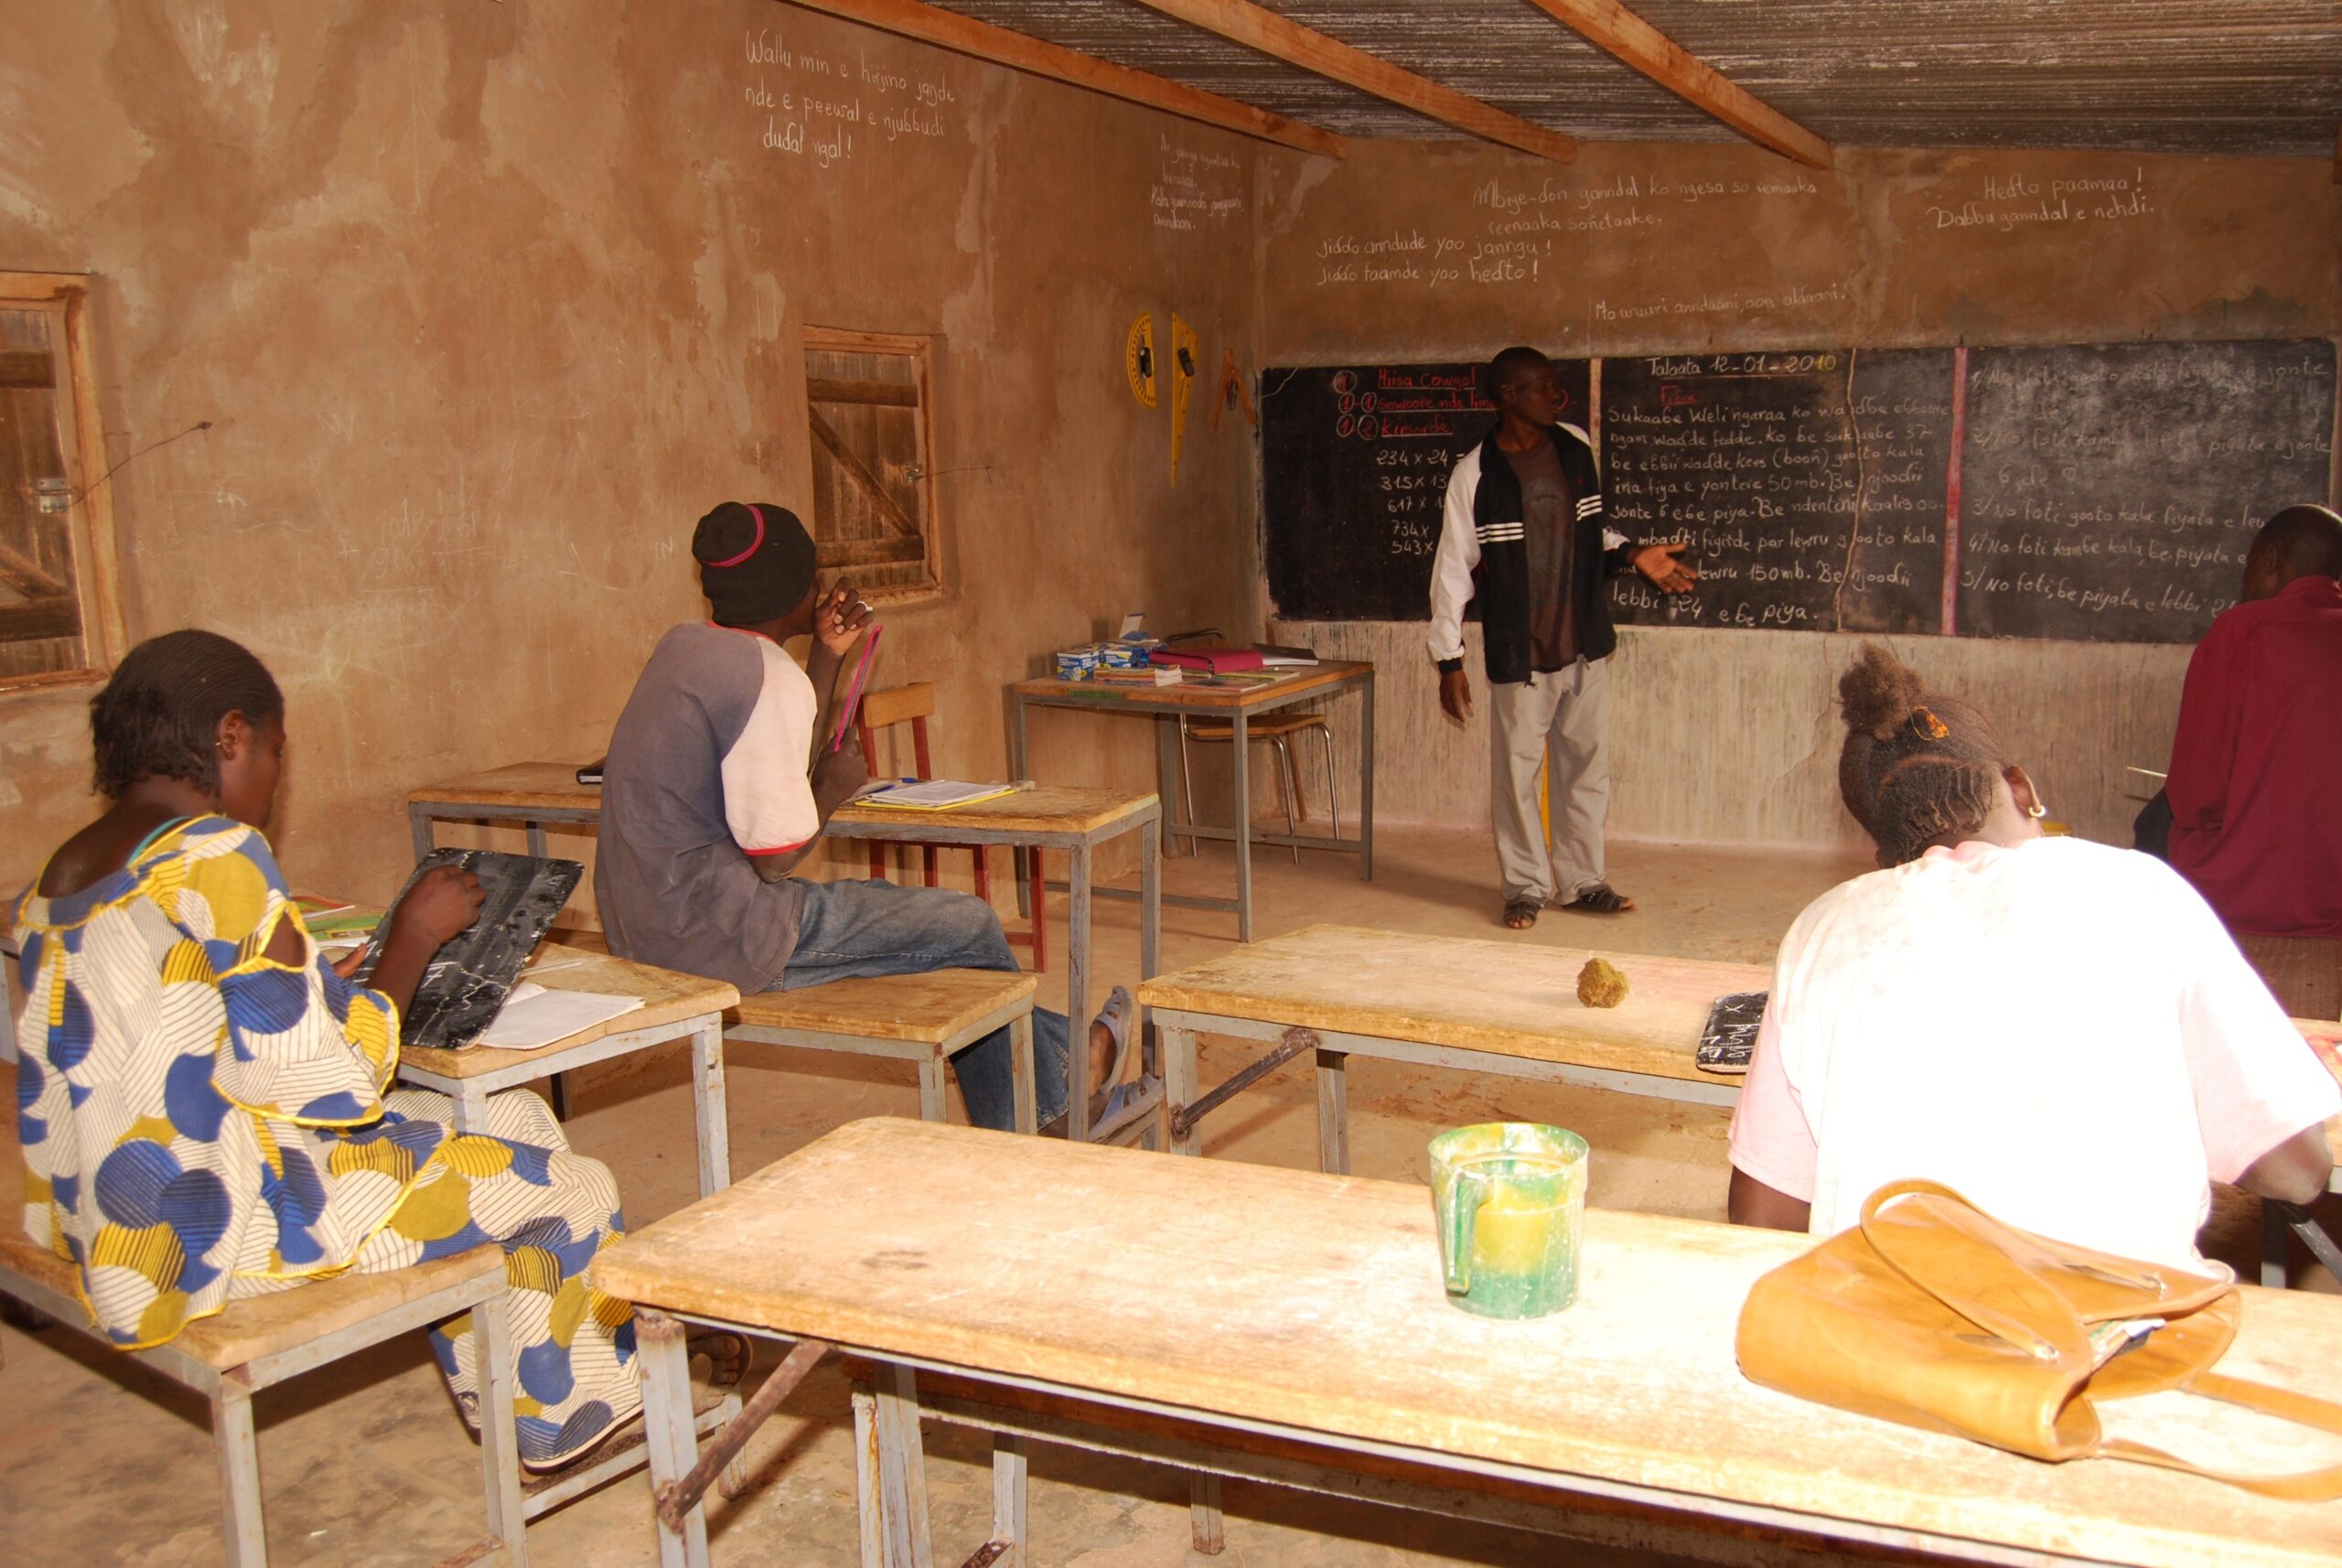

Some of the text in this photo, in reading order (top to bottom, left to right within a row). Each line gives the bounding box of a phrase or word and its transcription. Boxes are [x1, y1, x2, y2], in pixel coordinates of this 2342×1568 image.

[746, 28, 791, 70] Wallu
[800, 49, 830, 74] min
[840, 63, 849, 78] e
[745, 74, 776, 109] nde
[783, 92, 793, 110] e
[804, 97, 859, 122] peewal
[868, 111, 877, 125] e
[1579, 176, 1638, 209] ganndal
[1650, 175, 1670, 196] ko
[1680, 181, 1724, 202] ngesa
[2000, 199, 2068, 231] ganndal
[2077, 209, 2086, 220] e
[1364, 229, 1427, 254] anndude
[1434, 237, 1465, 260] yoo
[1430, 265, 1459, 287] yoo
[1595, 300, 1617, 320] Mo
[1646, 357, 1702, 377] Talaata
[1377, 449, 1409, 466] 234
[1427, 449, 1448, 467] 24
[1887, 444, 1925, 457] kala
[1684, 480, 1695, 492] e
[1388, 497, 1413, 513] 617
[1434, 496, 1445, 510] 1
[2025, 499, 2063, 522] foti
[2067, 505, 2112, 527] gooto
[2224, 519, 2234, 528] e
[1391, 520, 1419, 537] 734
[1391, 541, 1423, 554] 543
[1758, 537, 1785, 553] par
[1789, 528, 1829, 549] lewru
[1903, 526, 1937, 544] kala
[2018, 533, 2047, 555] foti
[2238, 554, 2248, 564] e
[1697, 559, 1738, 580] lewru
[1612, 580, 1661, 609] lebbi
[2145, 600, 2155, 611] e
